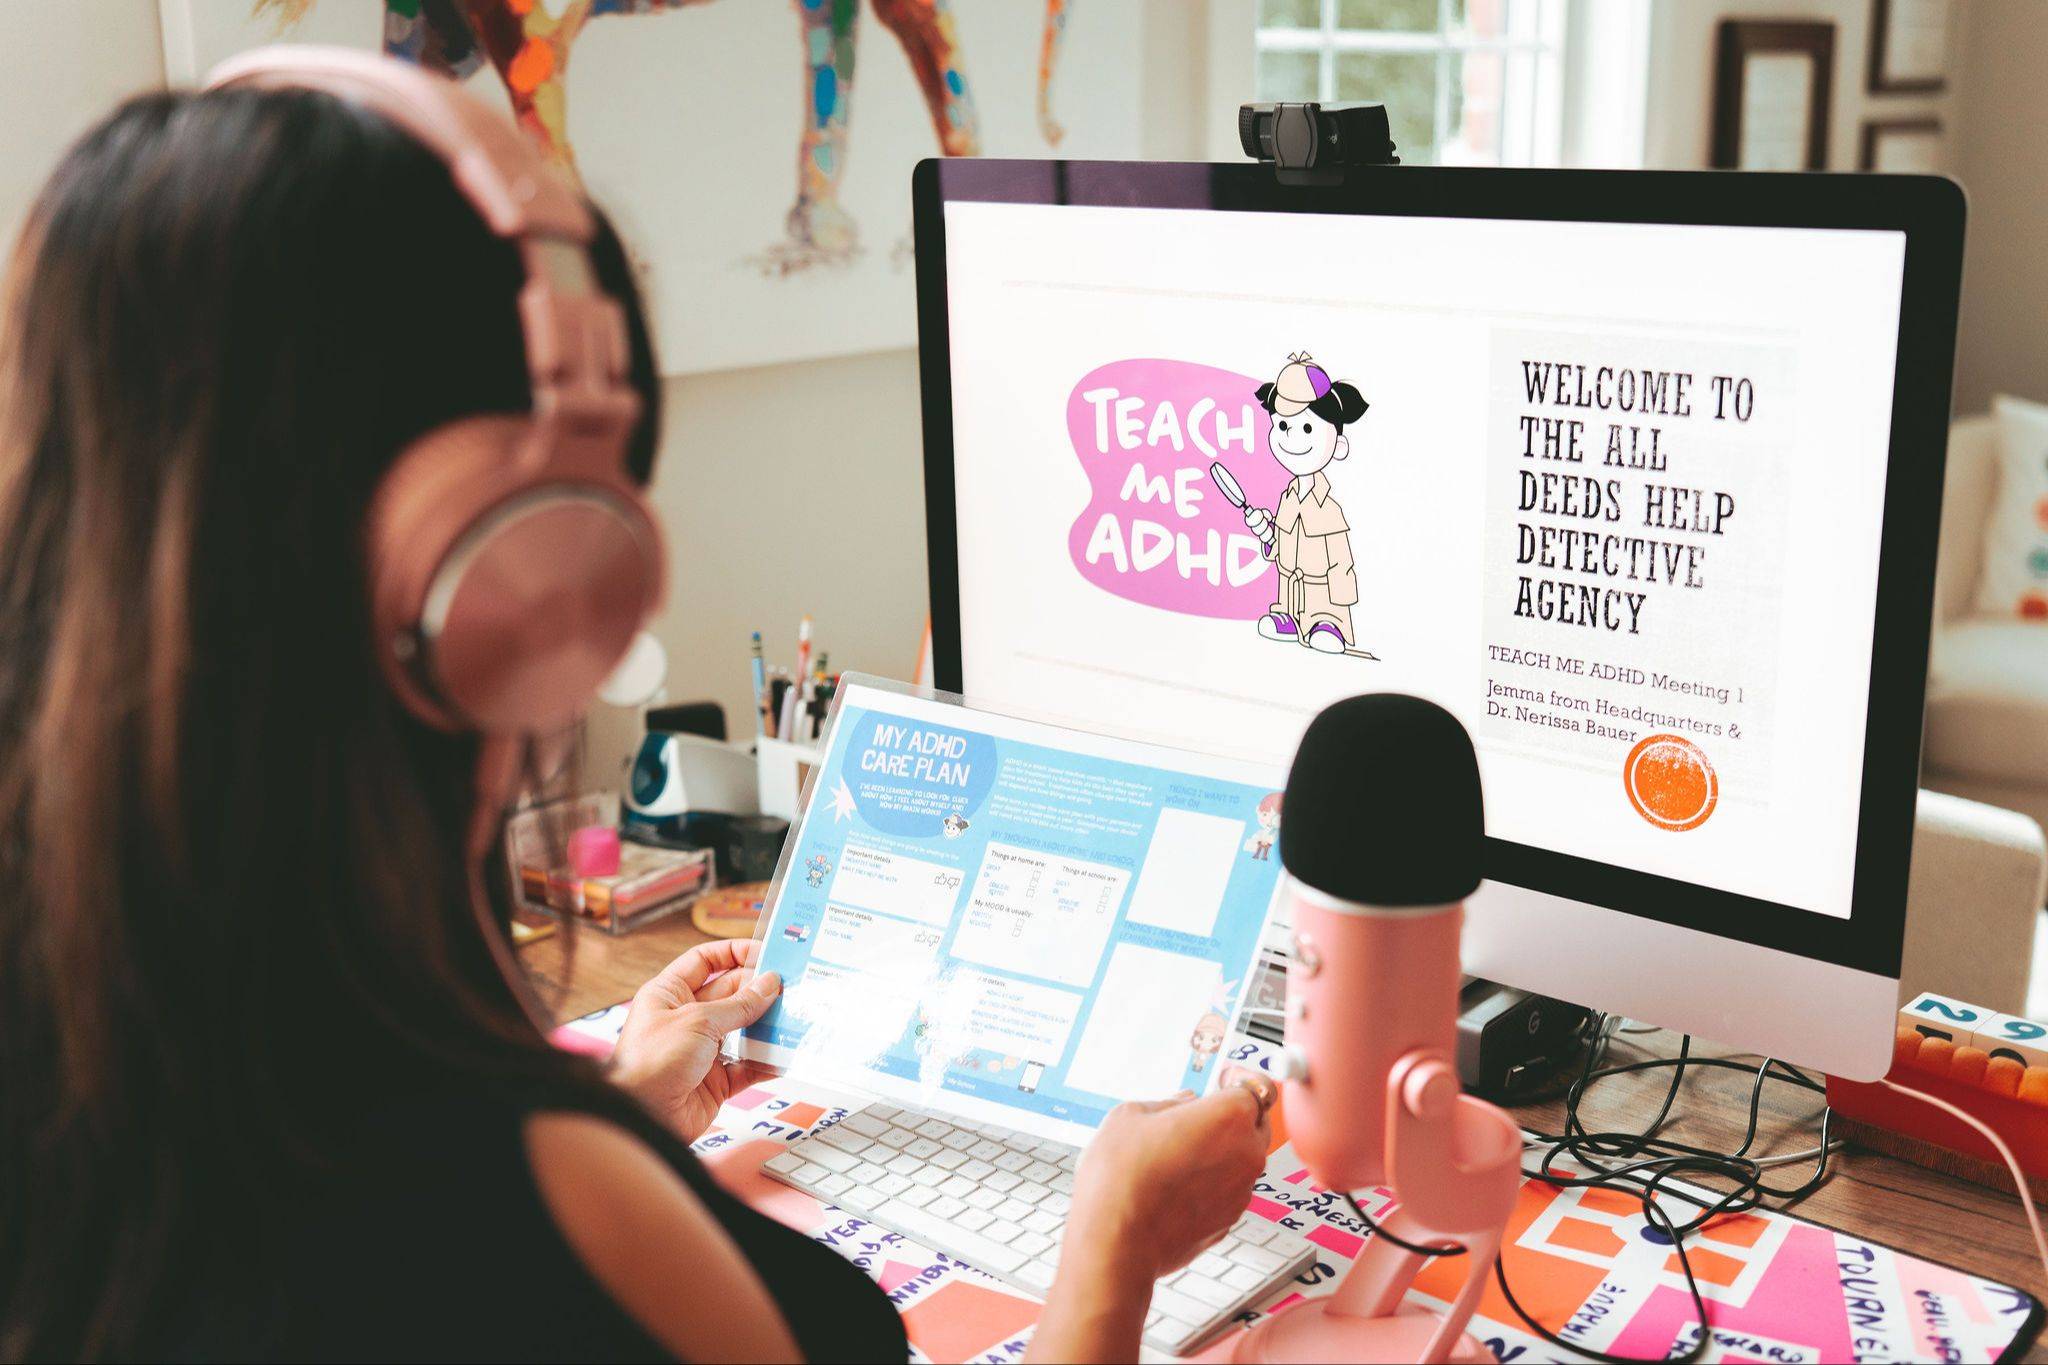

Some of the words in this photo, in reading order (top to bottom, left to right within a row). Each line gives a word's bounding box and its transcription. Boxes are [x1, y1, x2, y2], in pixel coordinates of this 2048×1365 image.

[1522, 361, 1693, 417] WELCOME
[1711, 375, 1754, 422] TO
[1083, 387, 1255, 458] TEACH
[1520, 415, 1584, 463] THE
[1603, 424, 1667, 472] ALL
[1119, 462, 1205, 518] ME
[1518, 470, 1621, 522] DEEDS
[1643, 484, 1736, 535] HELP
[1085, 513, 1272, 588] ADHD
[1516, 523, 1705, 589] DETECTIVE
[1514, 576, 1647, 634] AGENCY
[1488, 645, 1551, 670] TEACH
[1555, 656, 1584, 676] ME
[1590, 664, 1645, 685] ADHD
[1651, 673, 1730, 704] Meeting
[1487, 679, 1544, 703] Jemma
[1550, 690, 1590, 712] from
[1595, 700, 1722, 736] Headquarters
[1729, 725, 1743, 740] &
[1487, 702, 1511, 720] Dr.
[1515, 707, 1580, 732] Nerissa
[1585, 720, 1638, 743] Bauer
[860, 750, 911, 778] CARE
[913, 756, 971, 787] PLAN
[872, 724, 907, 749] MY
[907, 730, 967, 759] ADHD
[847, 849, 872, 859] Important
[991, 850, 1010, 862] Things
[1018, 857, 1034, 866] home
[1062, 866, 1080, 877] Things
[1088, 872, 1106, 880] school
[828, 905, 854, 917] Important
[975, 899, 983, 908] My
[985, 902, 1005, 911] MOOD
